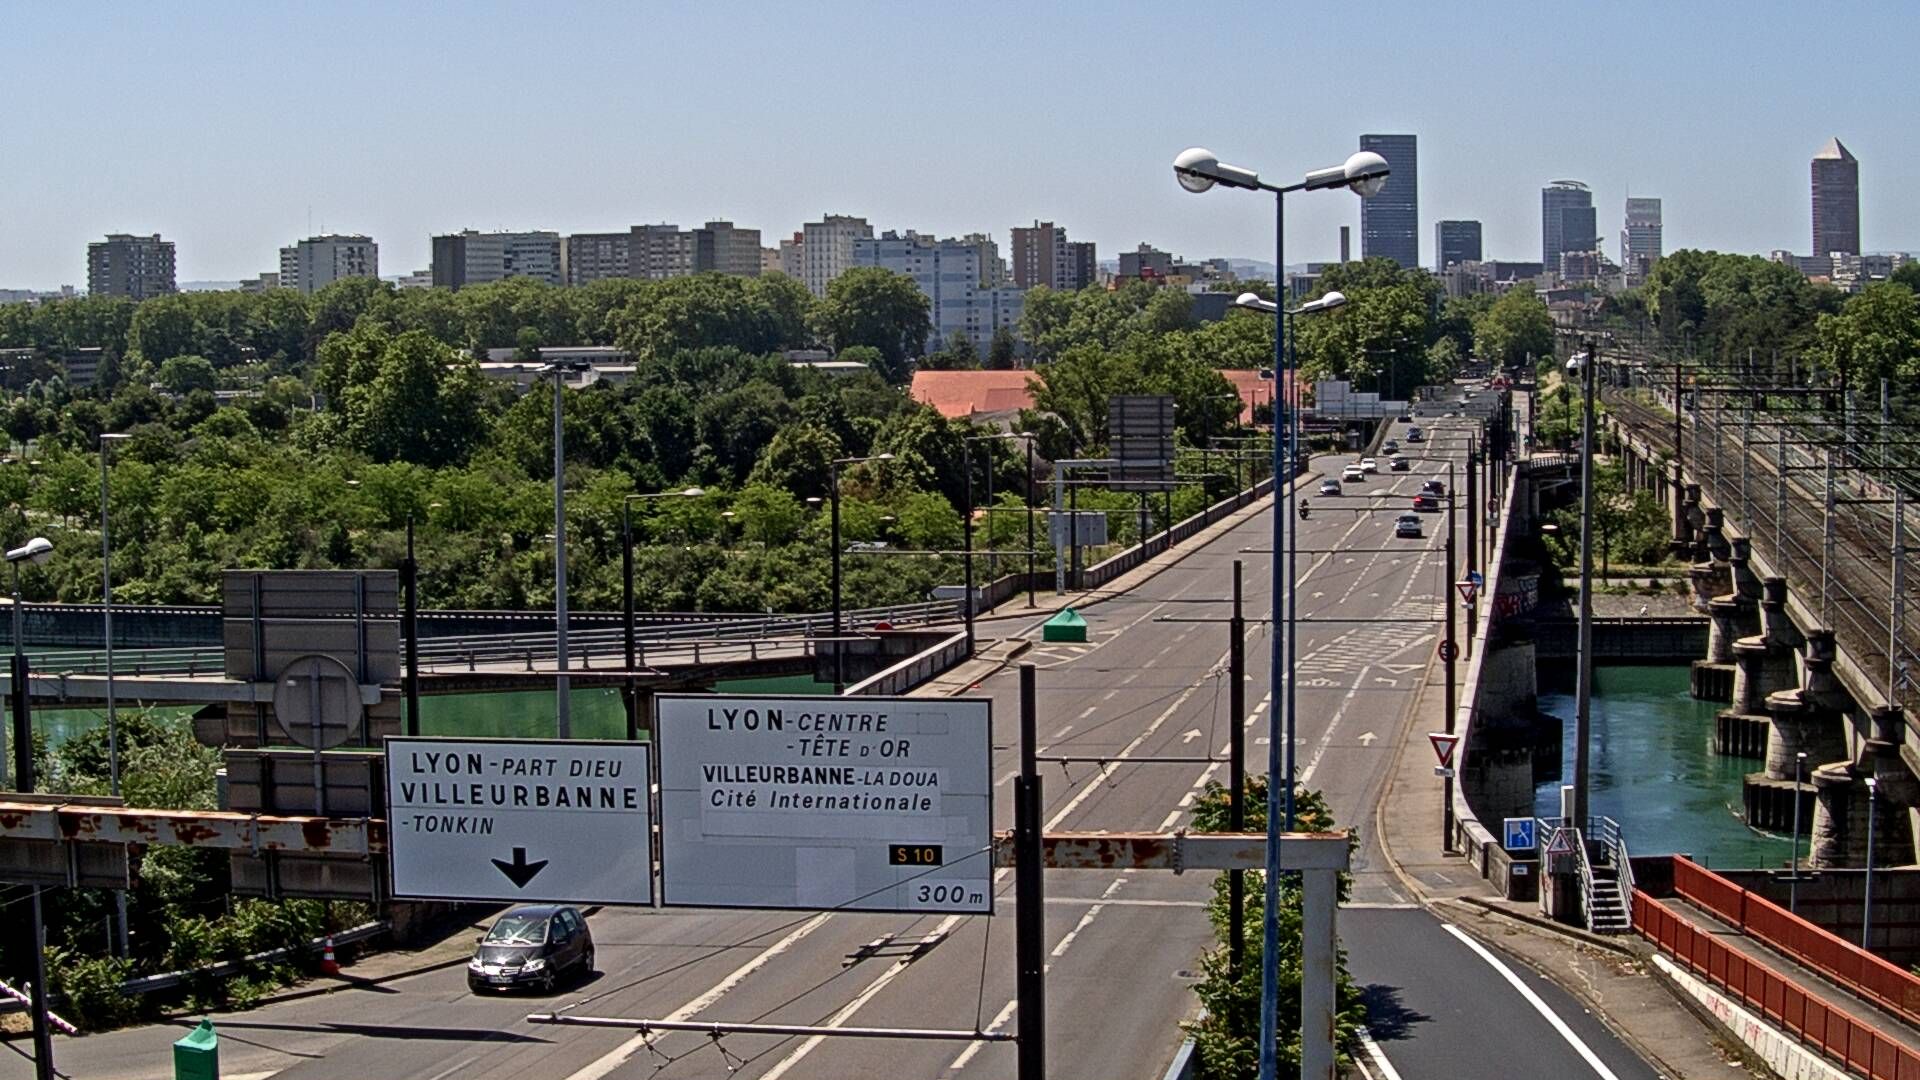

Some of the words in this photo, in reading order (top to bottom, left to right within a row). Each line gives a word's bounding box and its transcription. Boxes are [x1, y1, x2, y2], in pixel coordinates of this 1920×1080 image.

[708, 708, 888, 732] LYON-CENTRE
[411, 752, 558, 776] LYON-PART
[569, 760, 622, 778] DIEU
[889, 771, 938, 787] DOUA
[401, 782, 637, 809] VILLEURBANNE
[711, 789, 756, 807] Cité
[770, 791, 932, 811] Internationale
